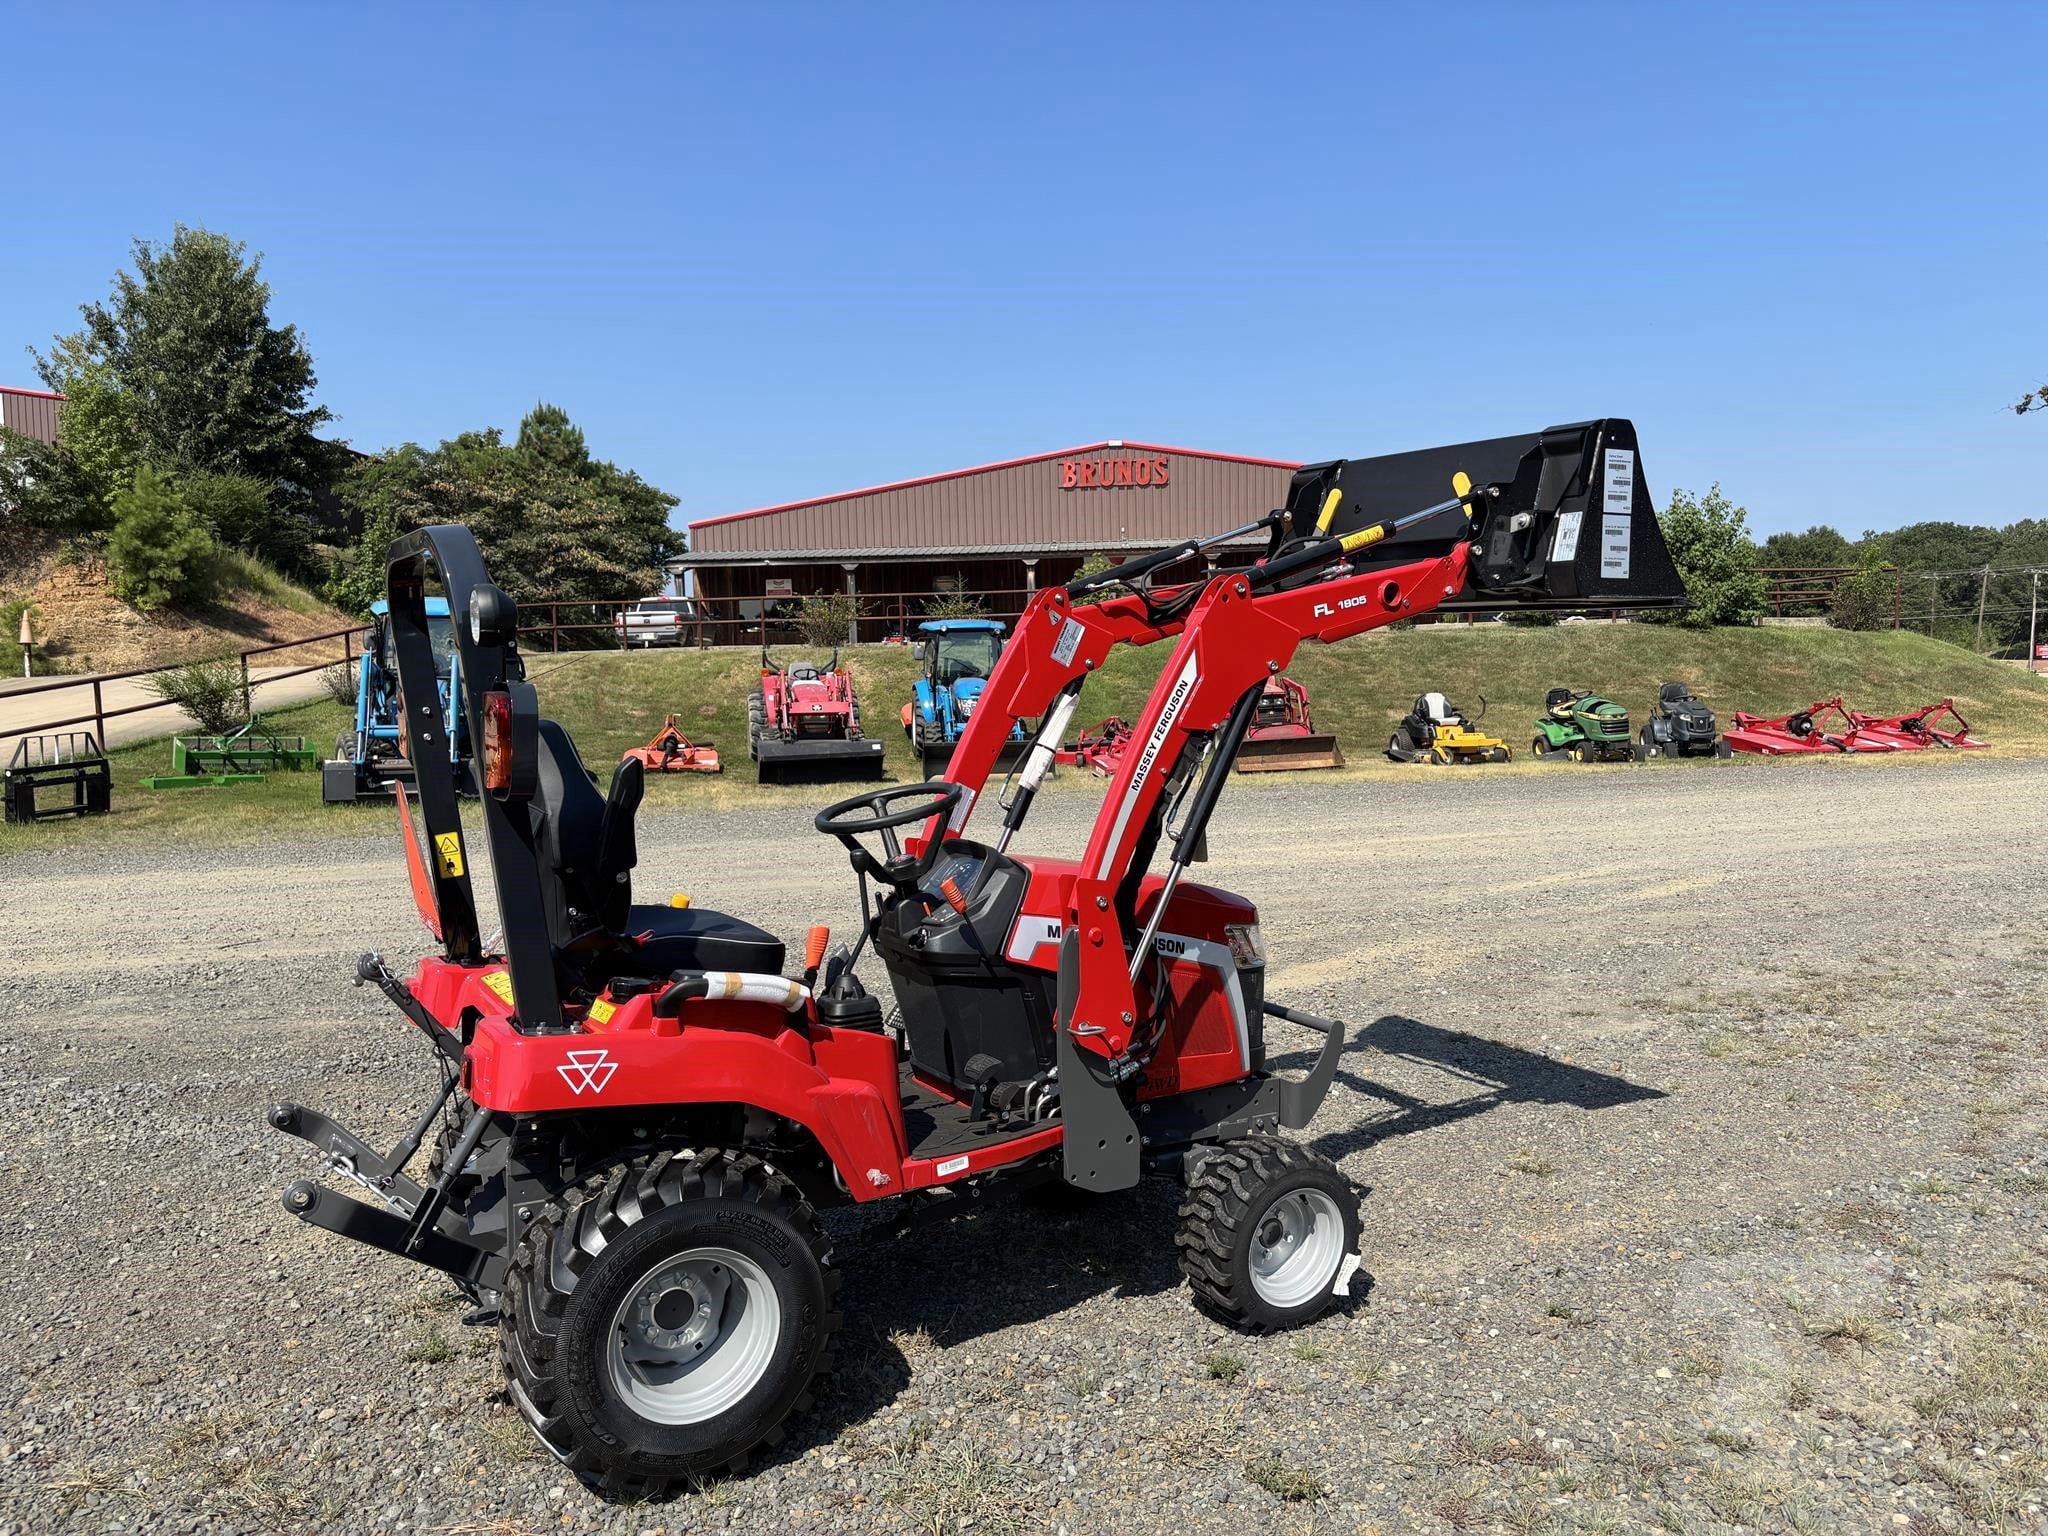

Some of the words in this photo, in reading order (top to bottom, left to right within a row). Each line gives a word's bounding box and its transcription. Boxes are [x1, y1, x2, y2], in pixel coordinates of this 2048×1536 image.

[1063, 456, 1169, 488] BRUNOS
[1313, 602, 1335, 618] FL
[1337, 594, 1367, 609] 1805
[1131, 742, 1157, 791] MASSEY
[1154, 680, 1188, 741] FERGUSON
